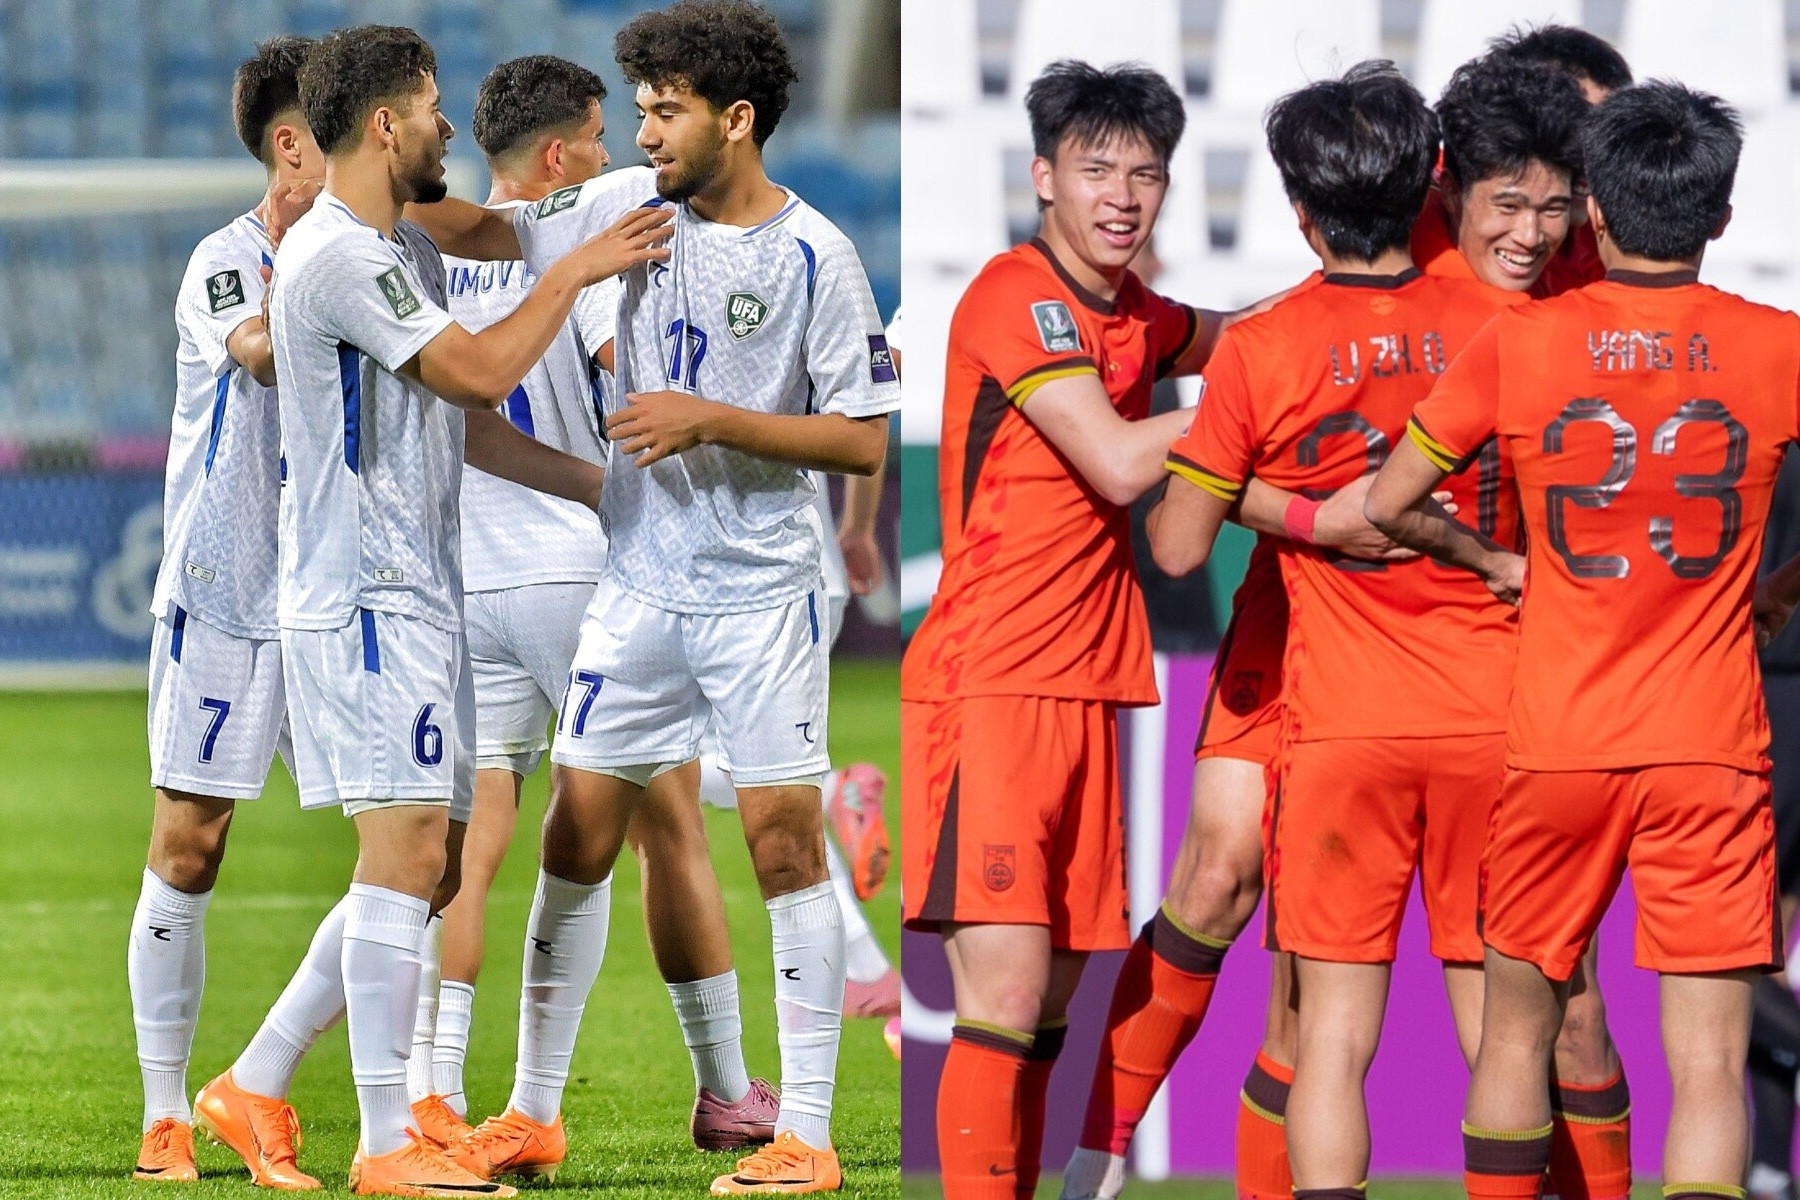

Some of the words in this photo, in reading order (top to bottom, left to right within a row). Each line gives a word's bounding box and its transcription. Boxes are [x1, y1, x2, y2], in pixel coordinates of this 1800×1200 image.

[447, 260, 515, 297] IMOV
[731, 296, 760, 323] UFA
[665, 318, 708, 392] 17
[1587, 329, 1673, 371] YANG
[1688, 332, 1718, 372] A.
[1542, 397, 1749, 580] 23
[198, 696, 231, 764] 7
[411, 703, 443, 768] 6
